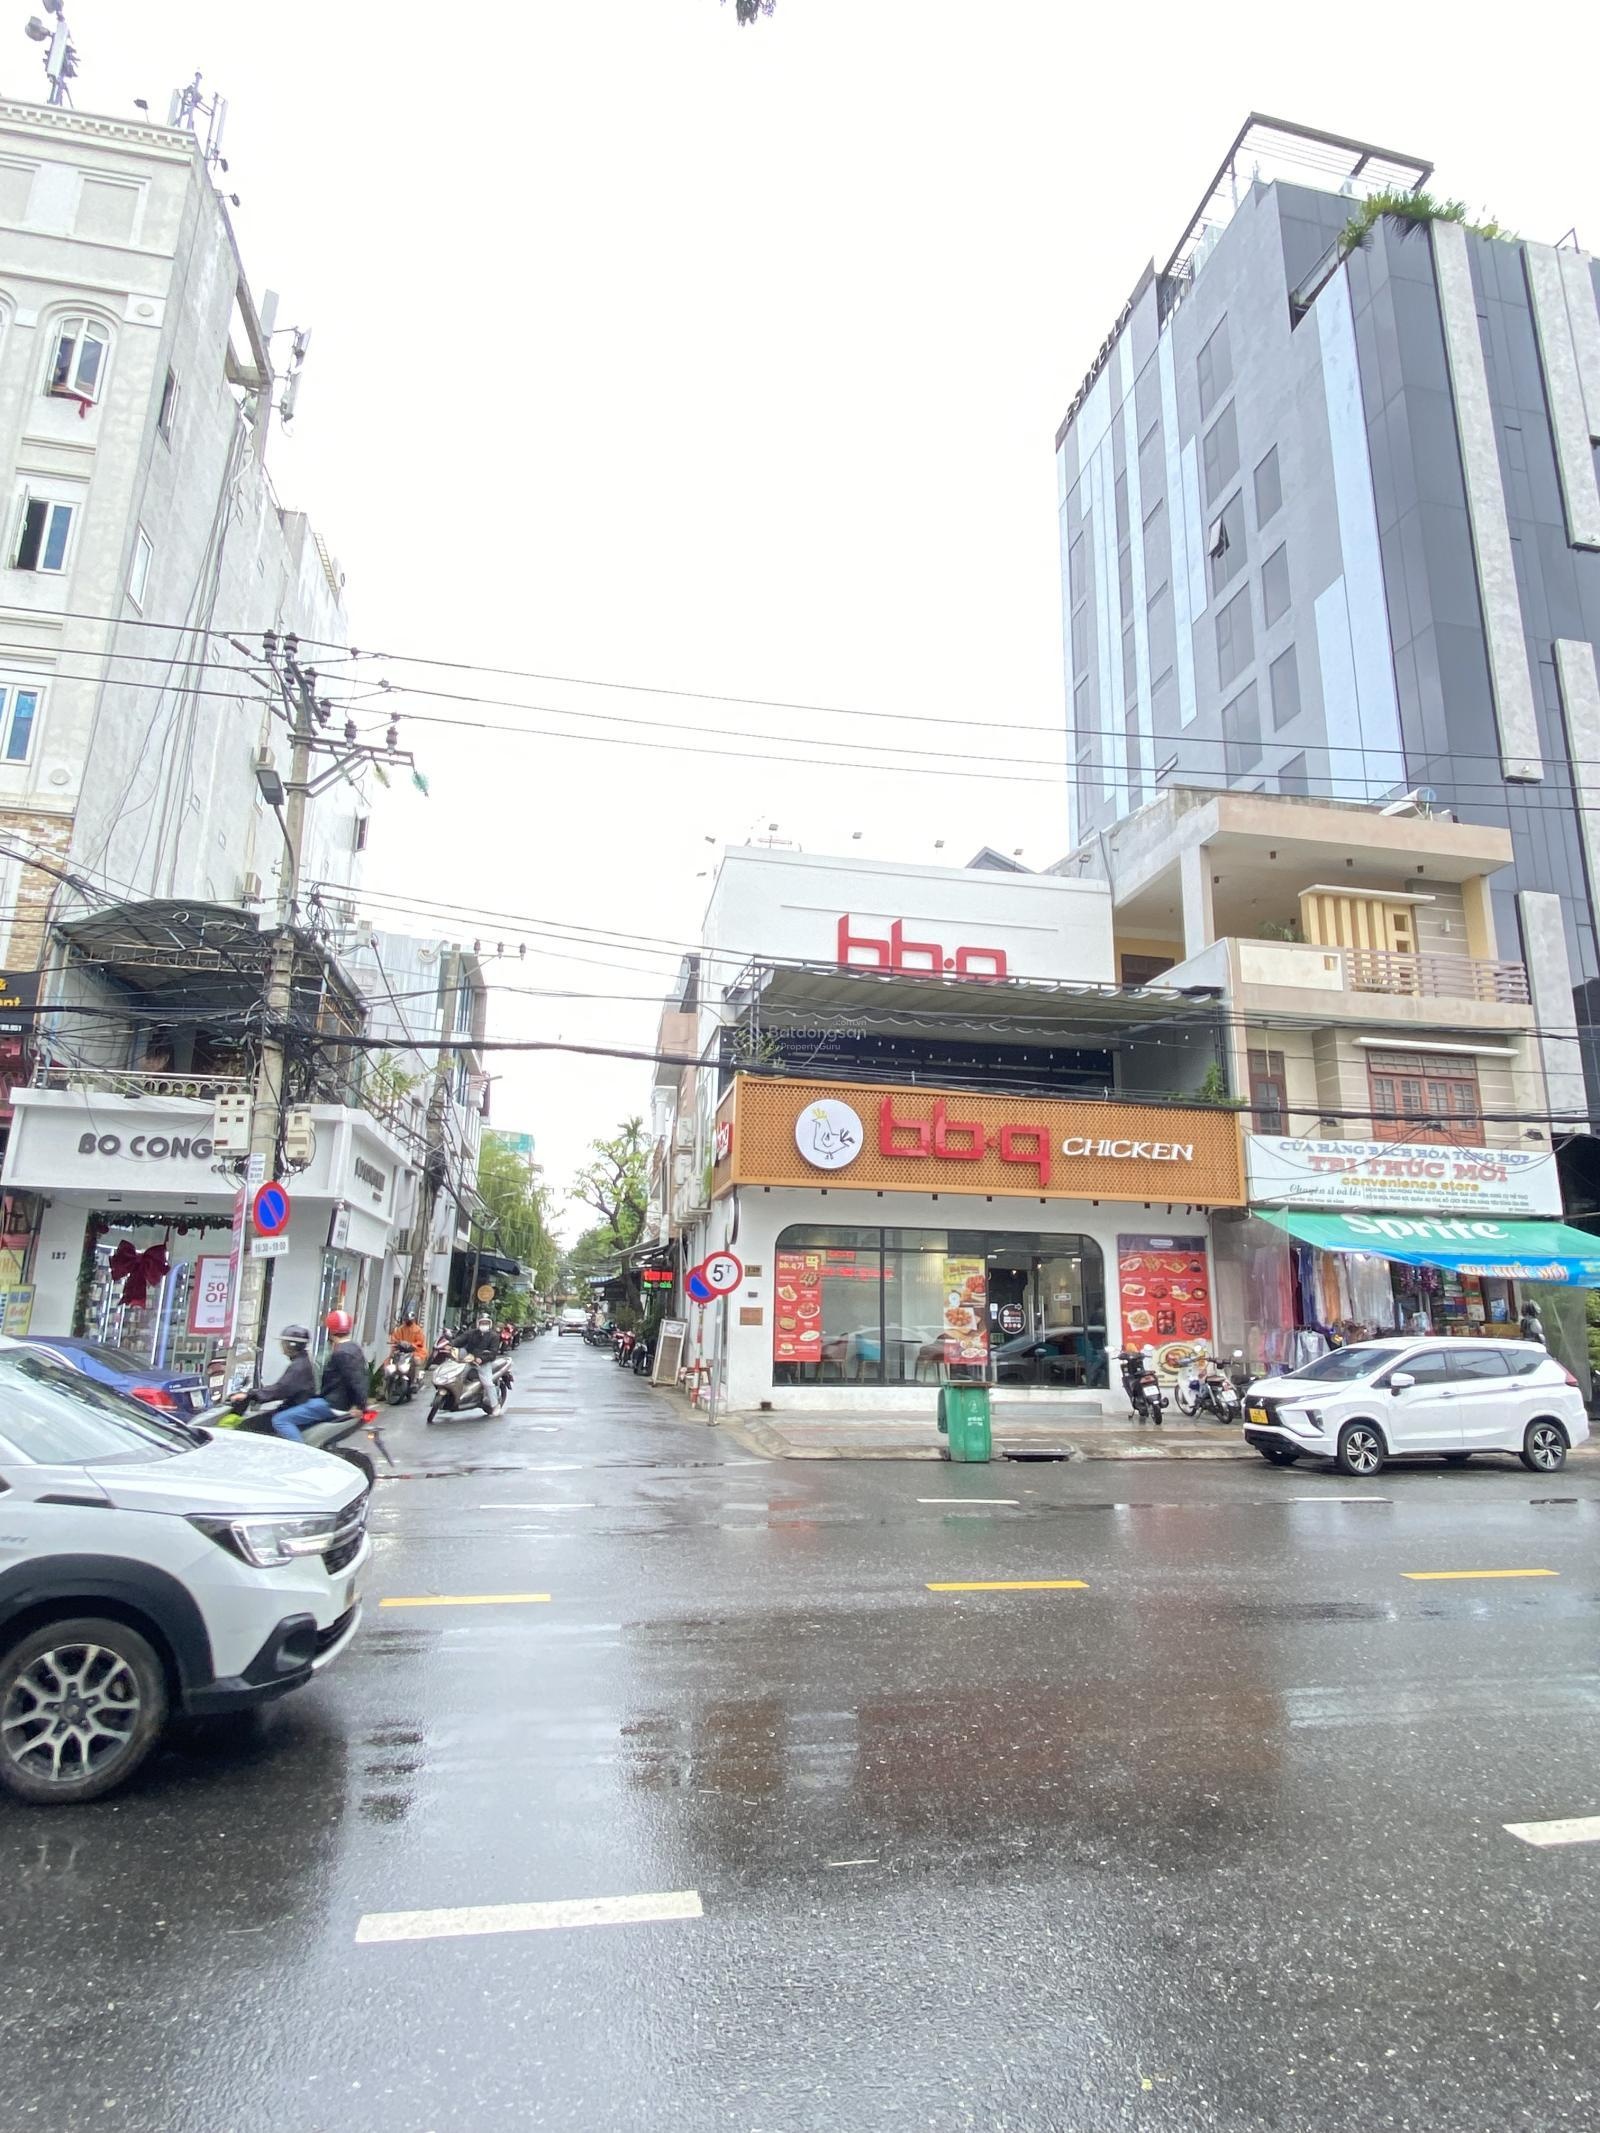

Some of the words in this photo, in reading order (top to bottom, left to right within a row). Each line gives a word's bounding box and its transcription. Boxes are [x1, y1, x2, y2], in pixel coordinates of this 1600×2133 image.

[78, 1132, 121, 1156] BO
[130, 1136, 213, 1159] CONG
[1062, 1137, 1194, 1161] CHICKEN
[1317, 1141, 1365, 1155] HÀNG
[1308, 1155, 1358, 1174] TRI
[1365, 1157, 1445, 1179] THỨC
[1453, 1162, 1508, 1182] MỚI
[1341, 1176, 1437, 1190] convenience
[1441, 1180, 1479, 1192] store
[1340, 1213, 1510, 1240] Sprite
[207, 1282, 229, 1292] 50
